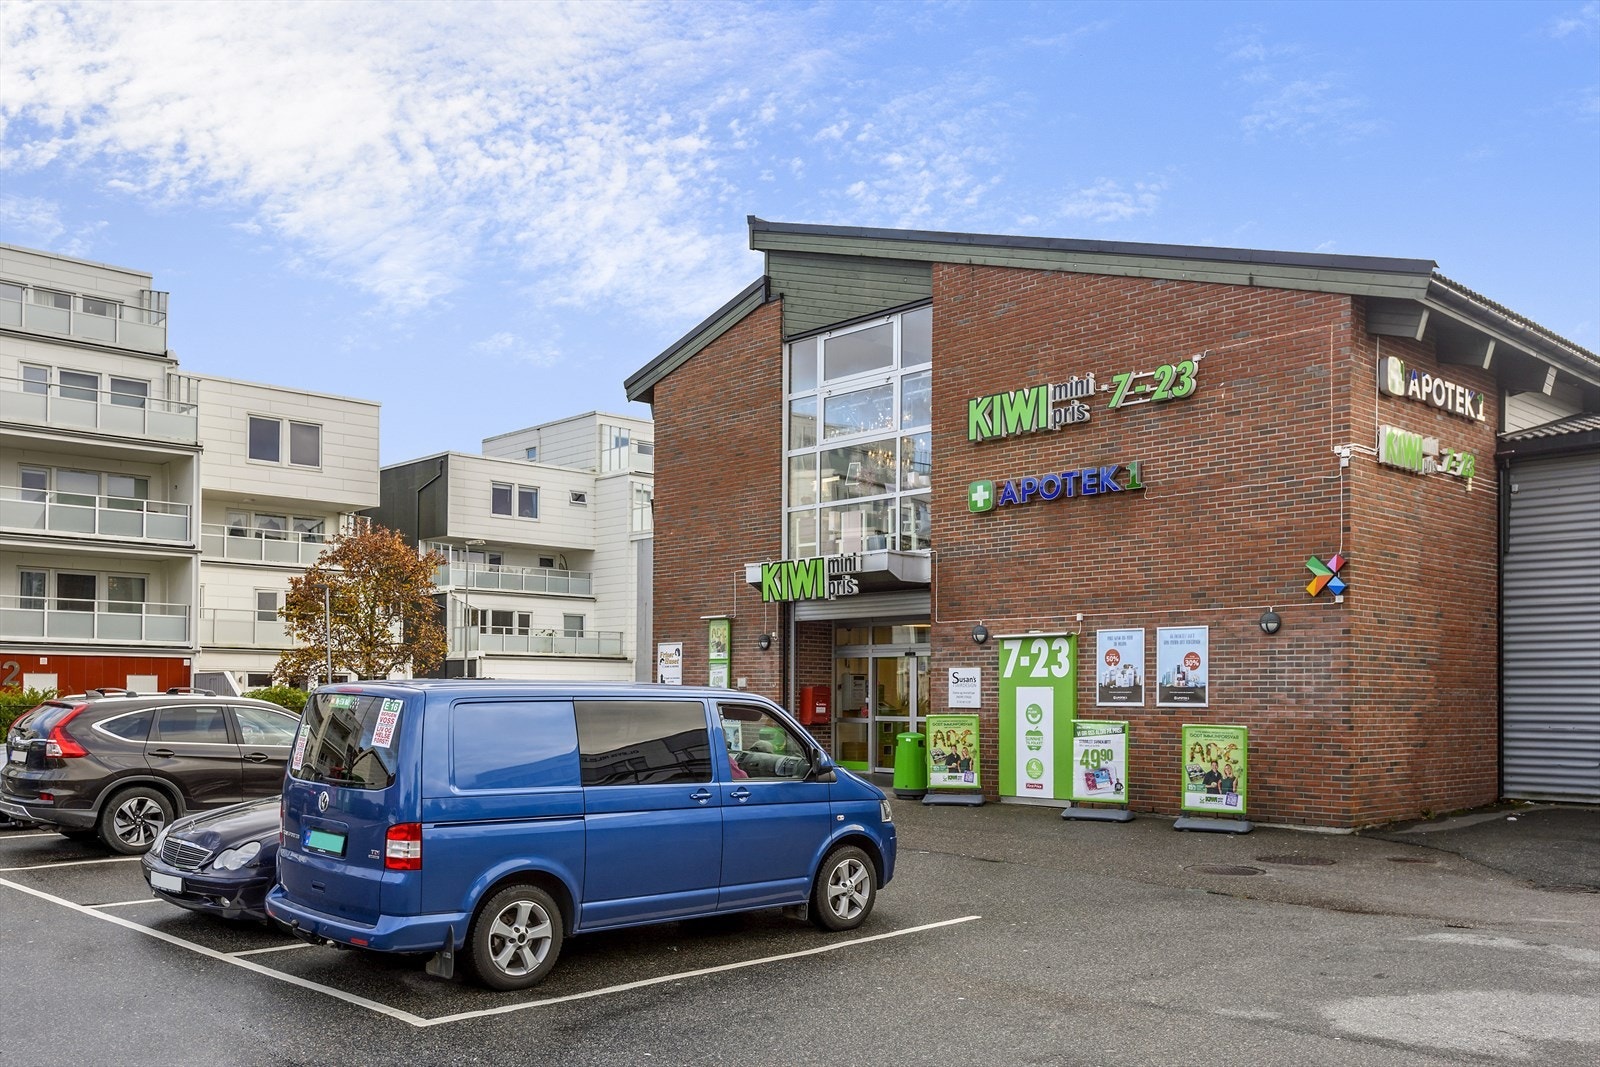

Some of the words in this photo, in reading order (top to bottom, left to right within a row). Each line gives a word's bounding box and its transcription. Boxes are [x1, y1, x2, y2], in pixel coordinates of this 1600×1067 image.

[1052, 373, 1095, 400] mini
[1408, 369, 1475, 418] APOTEK
[1476, 393, 1486, 421] 1
[968, 384, 1050, 441] KIWI
[1052, 401, 1090, 429] pris
[1385, 428, 1423, 473] KIWI
[999, 465, 1120, 506] APOTEK
[1125, 461, 1143, 490] 1
[761, 557, 825, 602] KIWI
[828, 553, 859, 574] mini
[828, 575, 859, 598] pris
[1003, 638, 1070, 678] 7-23
[1185, 659, 1200, 667] 30%
[952, 671, 977, 684] Susan's
[379, 717, 395, 725] VOSS
